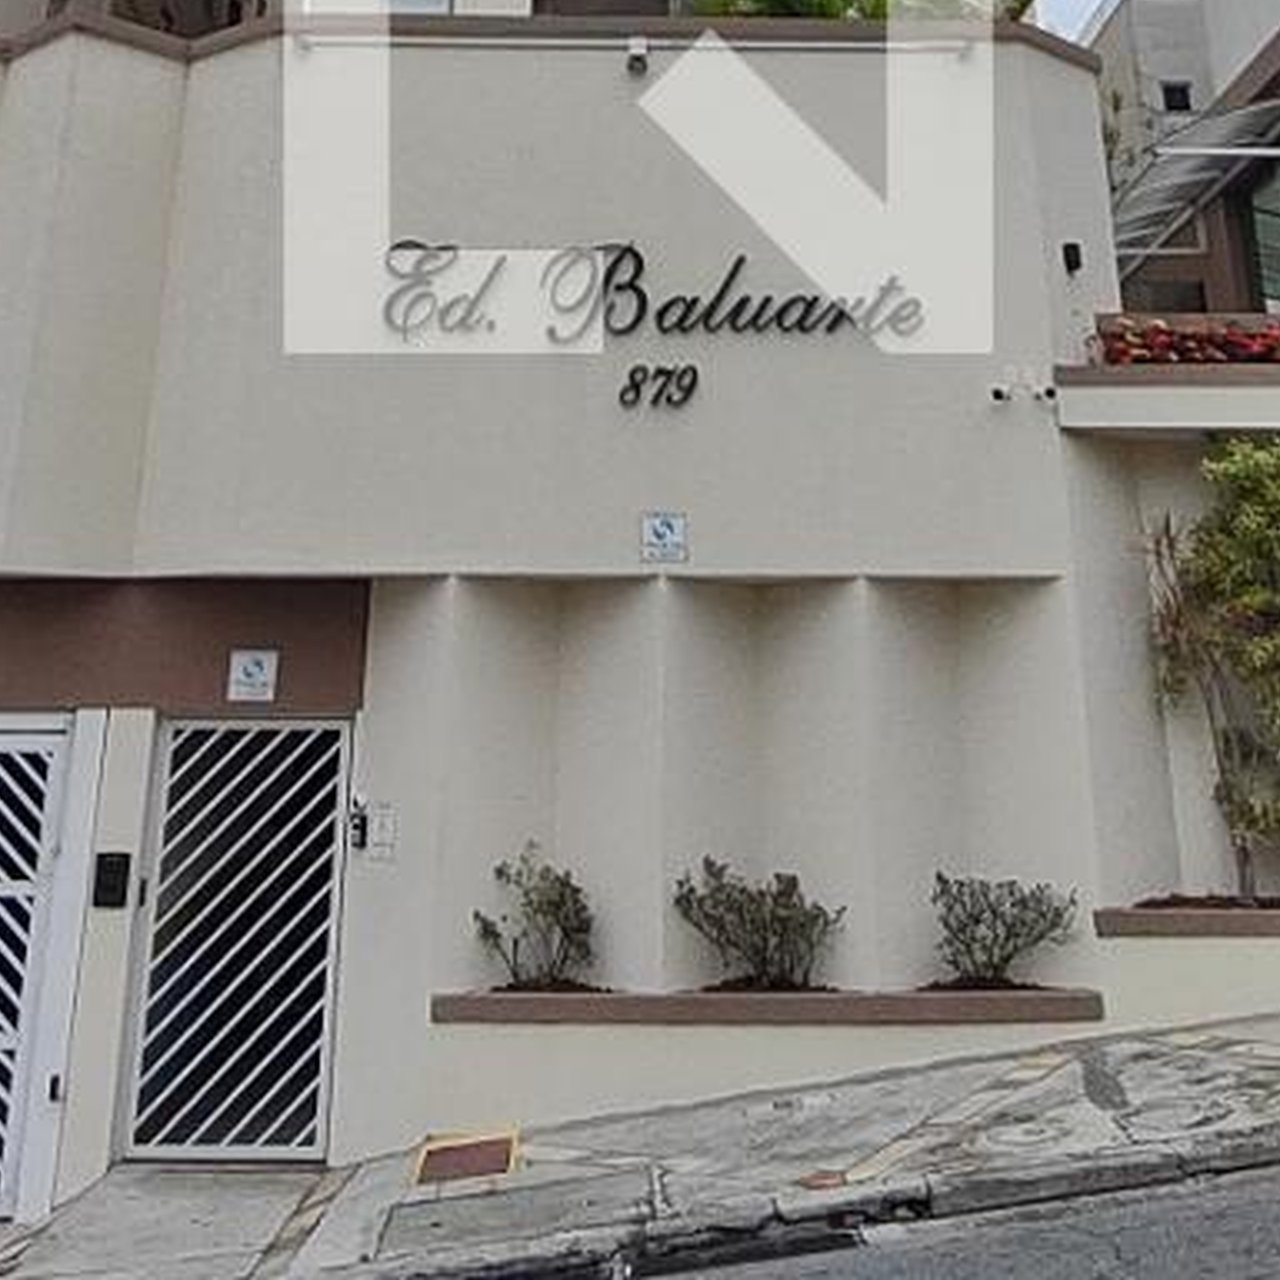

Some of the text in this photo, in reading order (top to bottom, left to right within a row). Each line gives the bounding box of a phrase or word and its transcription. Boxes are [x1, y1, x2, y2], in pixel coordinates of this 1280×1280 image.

[383, 239, 926, 344] Ed. Baluarte
[619, 364, 699, 410] 879
